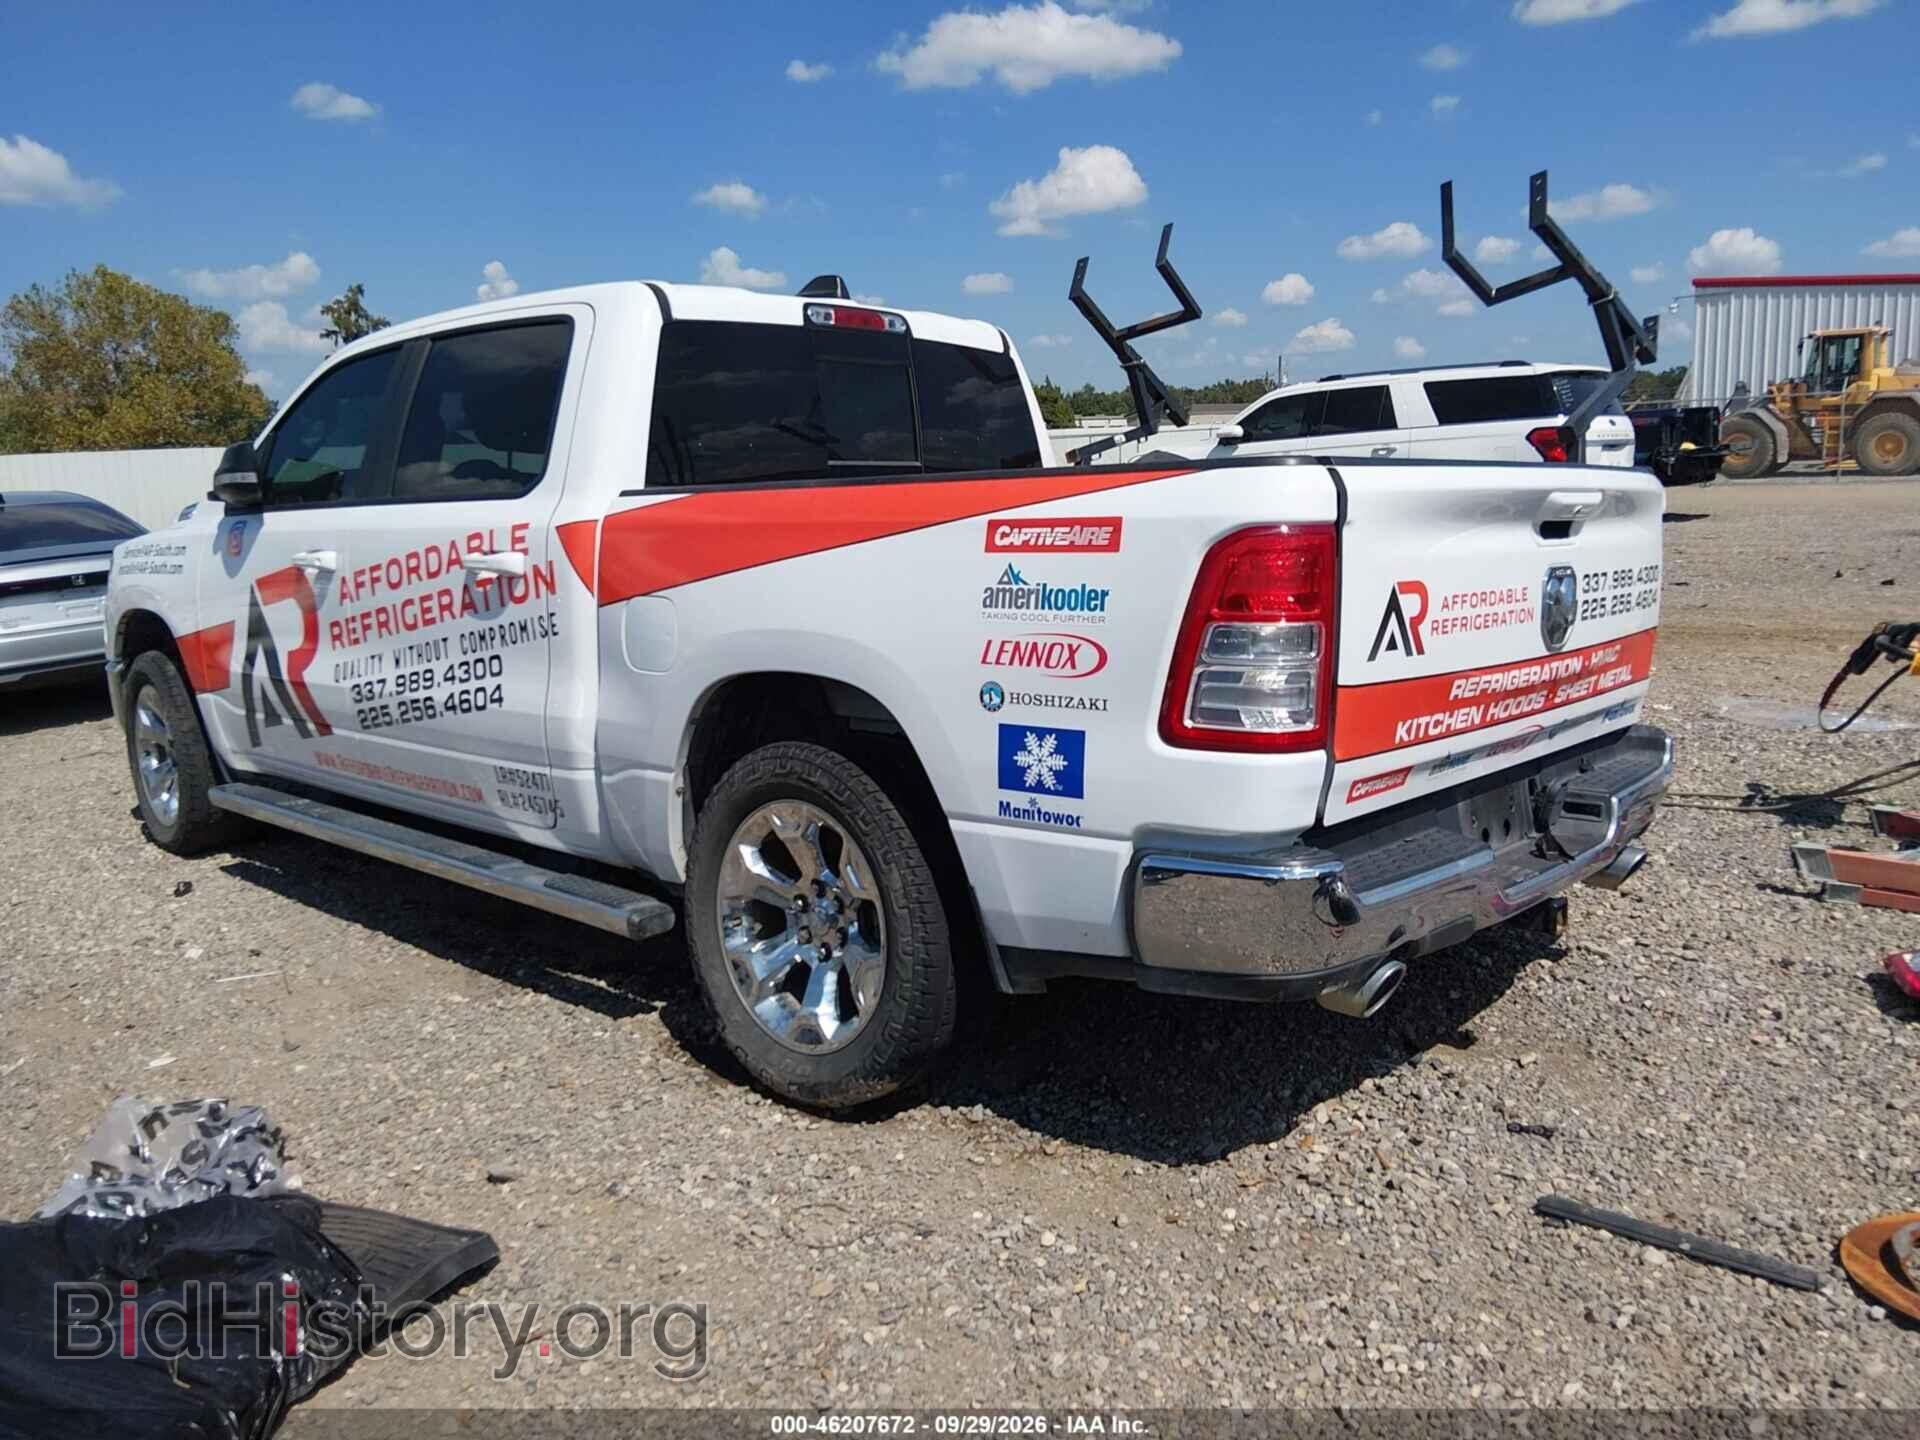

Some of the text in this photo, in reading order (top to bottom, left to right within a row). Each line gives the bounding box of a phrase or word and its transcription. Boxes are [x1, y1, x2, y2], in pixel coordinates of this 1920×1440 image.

[329, 560, 557, 651] REFRIGERATION
[982, 582, 1110, 613] amerikooler
[1440, 586, 1529, 613] AFFORDABLE
[981, 611, 1106, 625] TAKING COOL FURTHER
[1430, 608, 1535, 637] REFRIGERATION
[334, 612, 559, 684] QUALITY WITHOUT COMPROMISE
[980, 639, 1082, 670] LENNOX
[351, 654, 504, 704] 337.989.4300
[1450, 656, 1583, 700] REFRIGERATION
[357, 683, 505, 731] 225.256.4604
[1008, 692, 1109, 712] HOSHIZAKI
[1395, 664, 1633, 745] KITCHEN HOODS SHEET METAL
[998, 799, 1082, 828] Manitowoc
